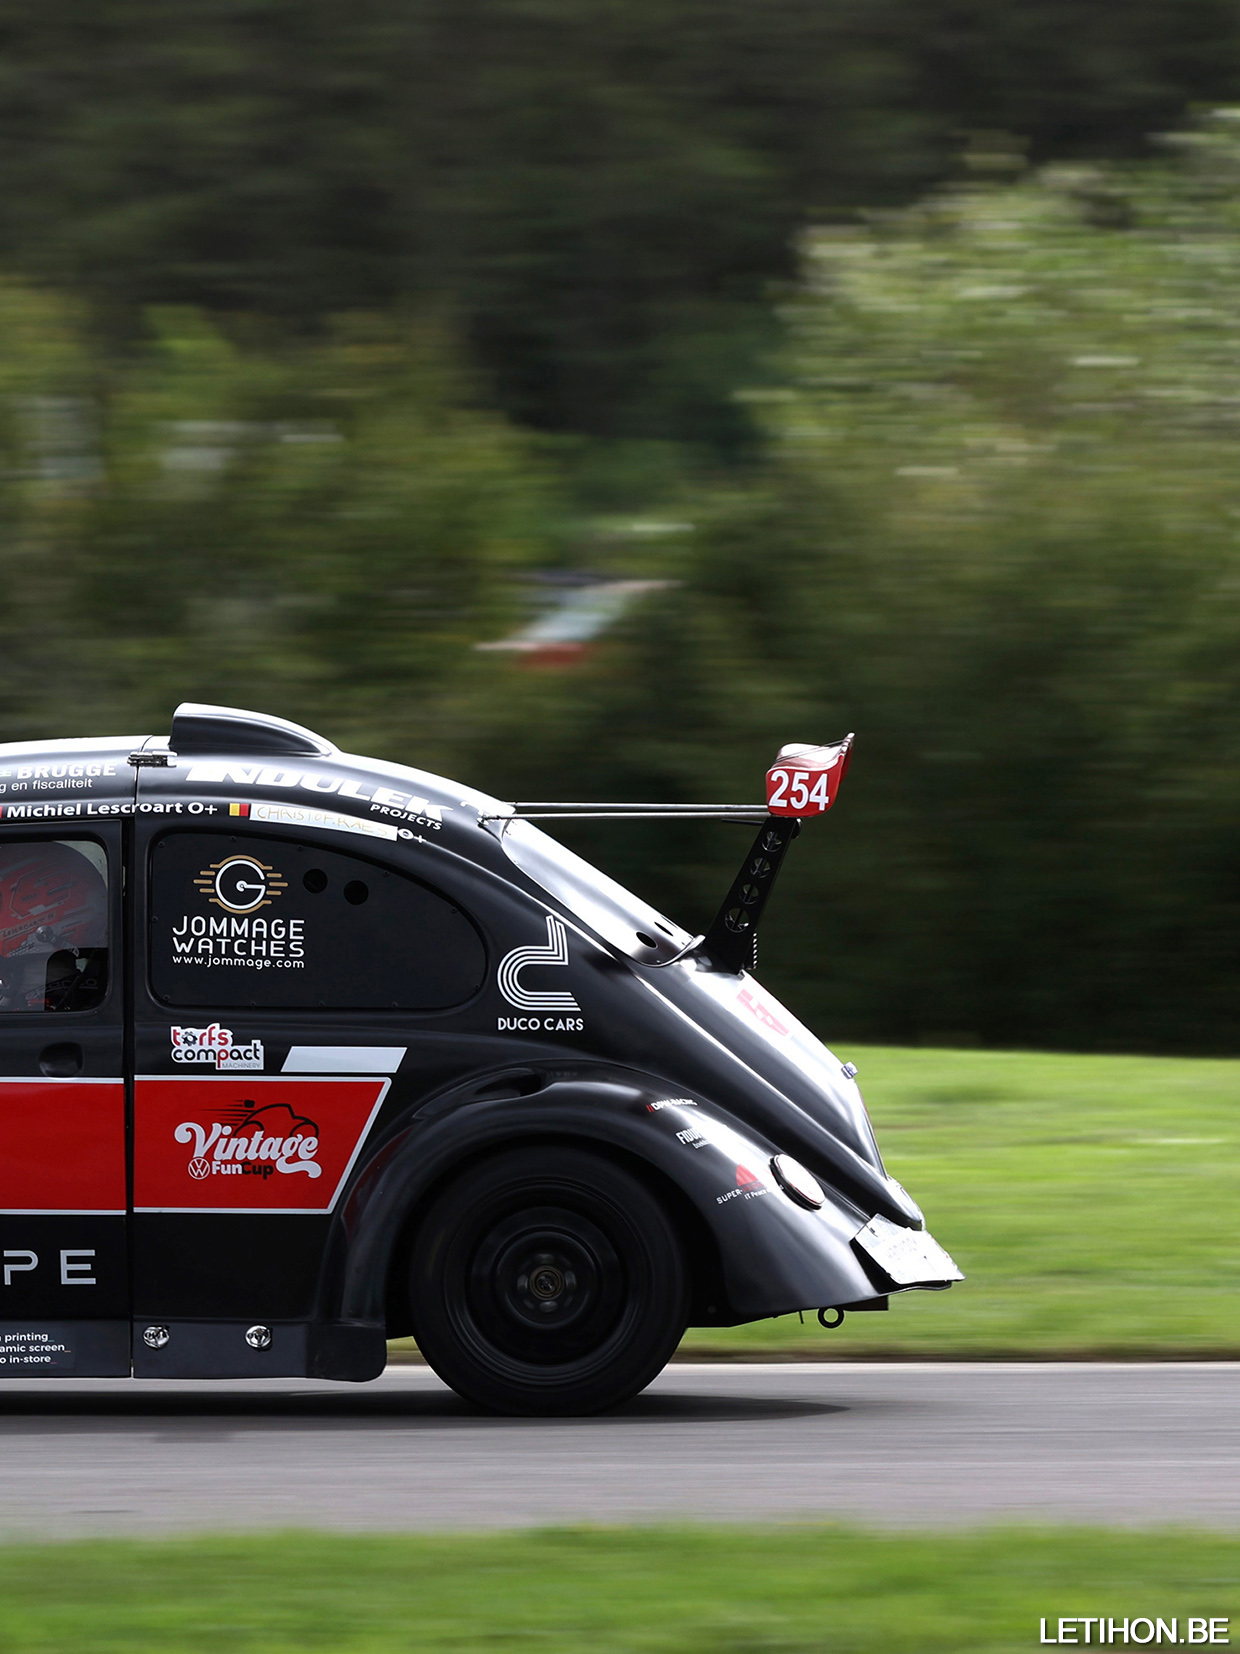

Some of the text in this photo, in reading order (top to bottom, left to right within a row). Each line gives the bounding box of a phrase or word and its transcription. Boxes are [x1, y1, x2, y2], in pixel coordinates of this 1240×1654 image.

[17, 763, 117, 780] BRUGGE
[12, 780, 28, 791] en
[32, 778, 93, 790] fiscaliteit
[769, 770, 829, 811] 254
[6, 803, 93, 818] Michiel
[96, 801, 183, 816] Lescroart
[370, 803, 442, 830] PROJECTS
[172, 916, 305, 939] JOMMAGE
[172, 938, 305, 957] WATCHES
[172, 955, 305, 969] www.jommage.com
[497, 1018, 584, 1032] DUCO CARS
[173, 1043, 260, 1068] compact
[174, 1122, 322, 1179] Vintage
[212, 1160, 274, 1180] FunCup
